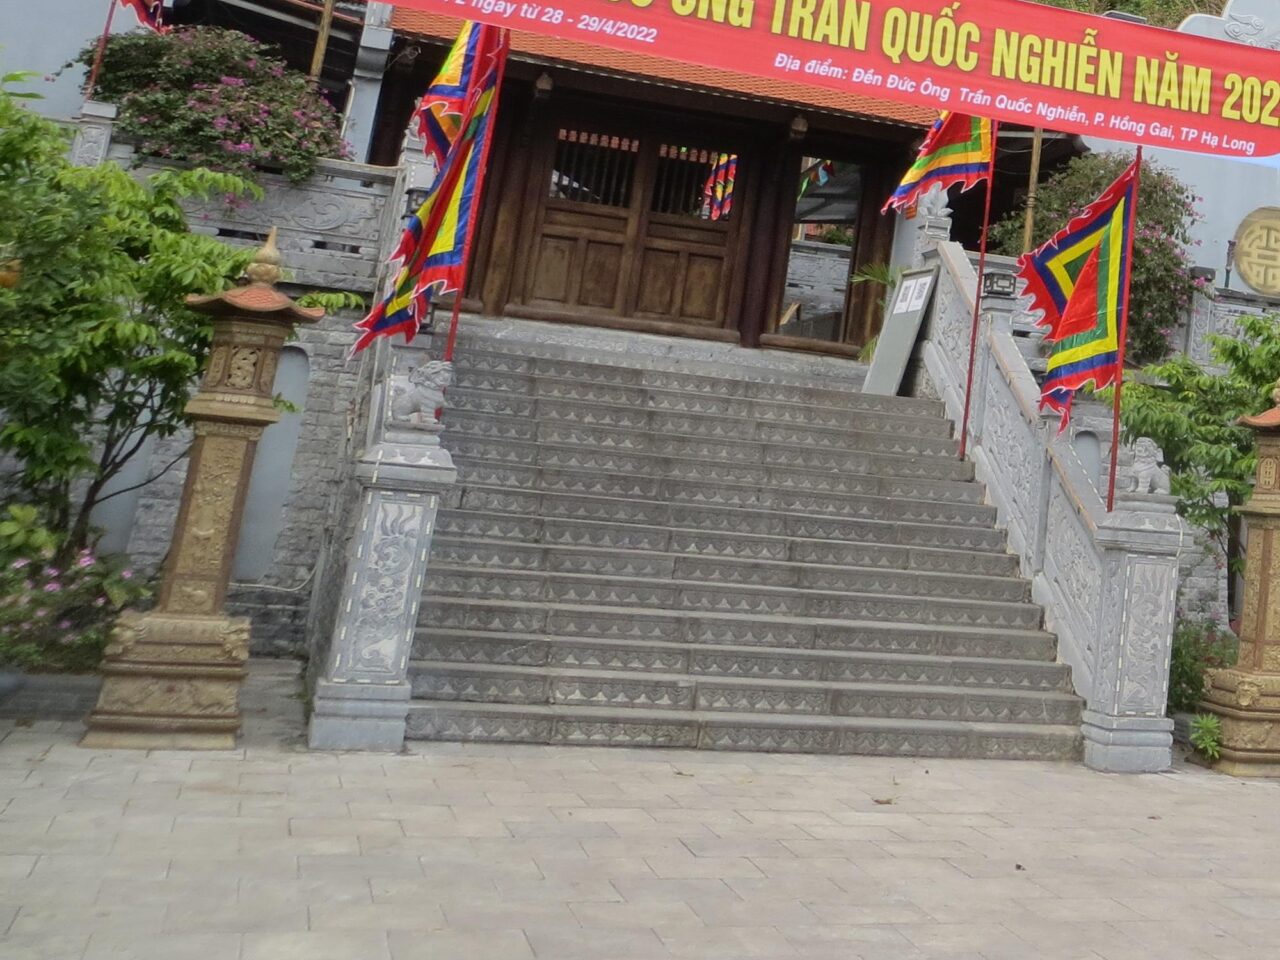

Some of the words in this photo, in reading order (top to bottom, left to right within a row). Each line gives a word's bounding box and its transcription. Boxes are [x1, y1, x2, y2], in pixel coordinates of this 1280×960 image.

[519, 3, 541, 19] từ
[541, 7, 564, 24] 28
[577, 15, 658, 43] 29/4/2022
[881, 1, 981, 72] QUỐC
[991, 27, 1123, 100] NGHIỄN
[1133, 50, 1212, 115] NĂM
[774, 52, 801, 72] Địa
[804, 58, 849, 80] điểm:
[852, 67, 882, 86] Đền
[886, 73, 917, 92] Đức
[919, 77, 951, 102] Ông
[959, 87, 992, 106] Trần
[995, 94, 1033, 114] Quốc
[1036, 101, 1089, 126] Nghiễn,
[1094, 112, 1105, 126] P.
[1109, 112, 1145, 136] Hồng
[1149, 121, 1175, 141] Gai,
[1180, 127, 1198, 142] TP
[1200, 131, 1219, 147] Hạ
[1222, 135, 1256, 155] Long
